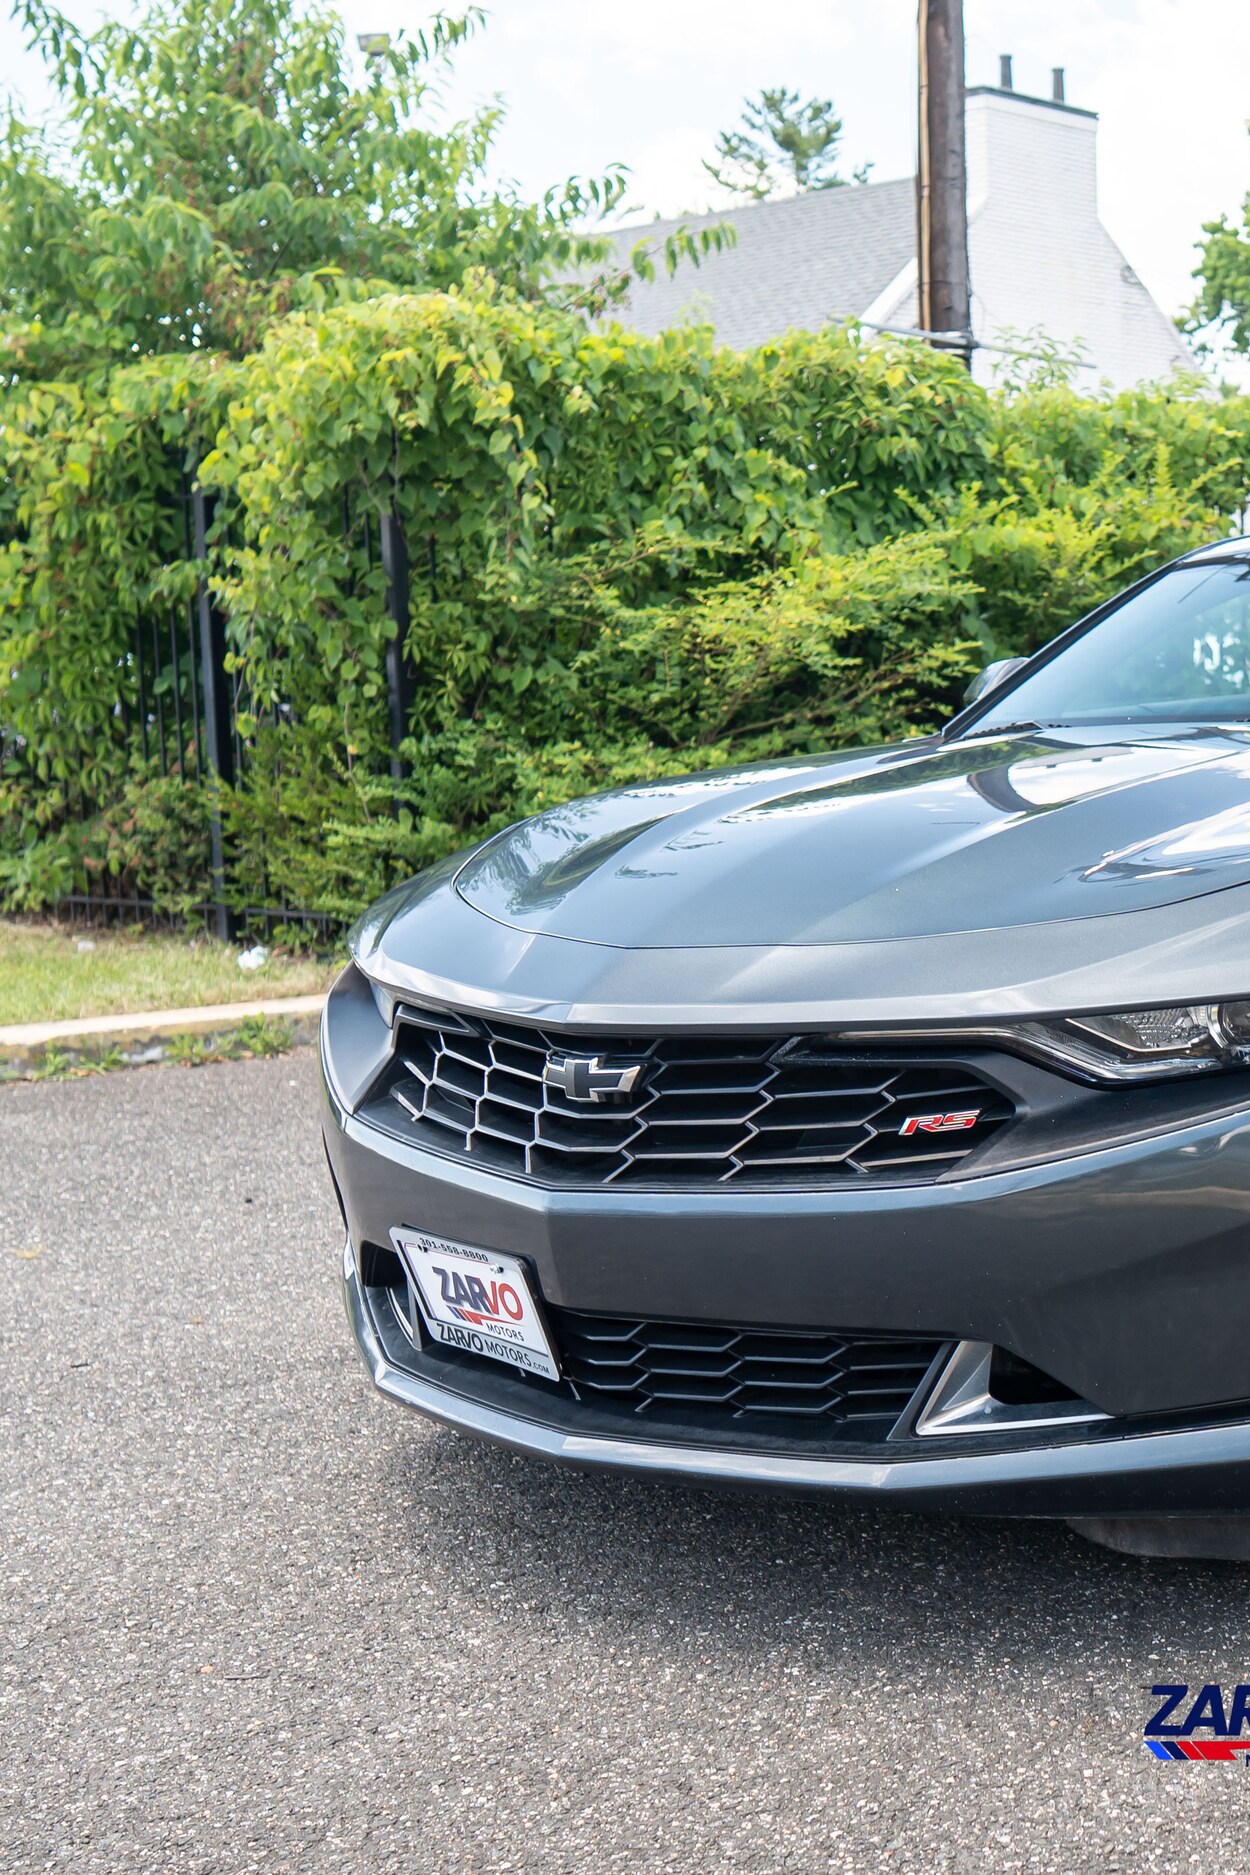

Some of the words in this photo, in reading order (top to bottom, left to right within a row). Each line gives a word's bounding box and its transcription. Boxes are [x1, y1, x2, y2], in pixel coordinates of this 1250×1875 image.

[898, 1109, 980, 1136] RS
[419, 1237, 489, 1262] 301-558-8800
[432, 1266, 523, 1320] ZARVO
[436, 1323, 484, 1352] ZARVO
[486, 1322, 525, 1342] MOTORS
